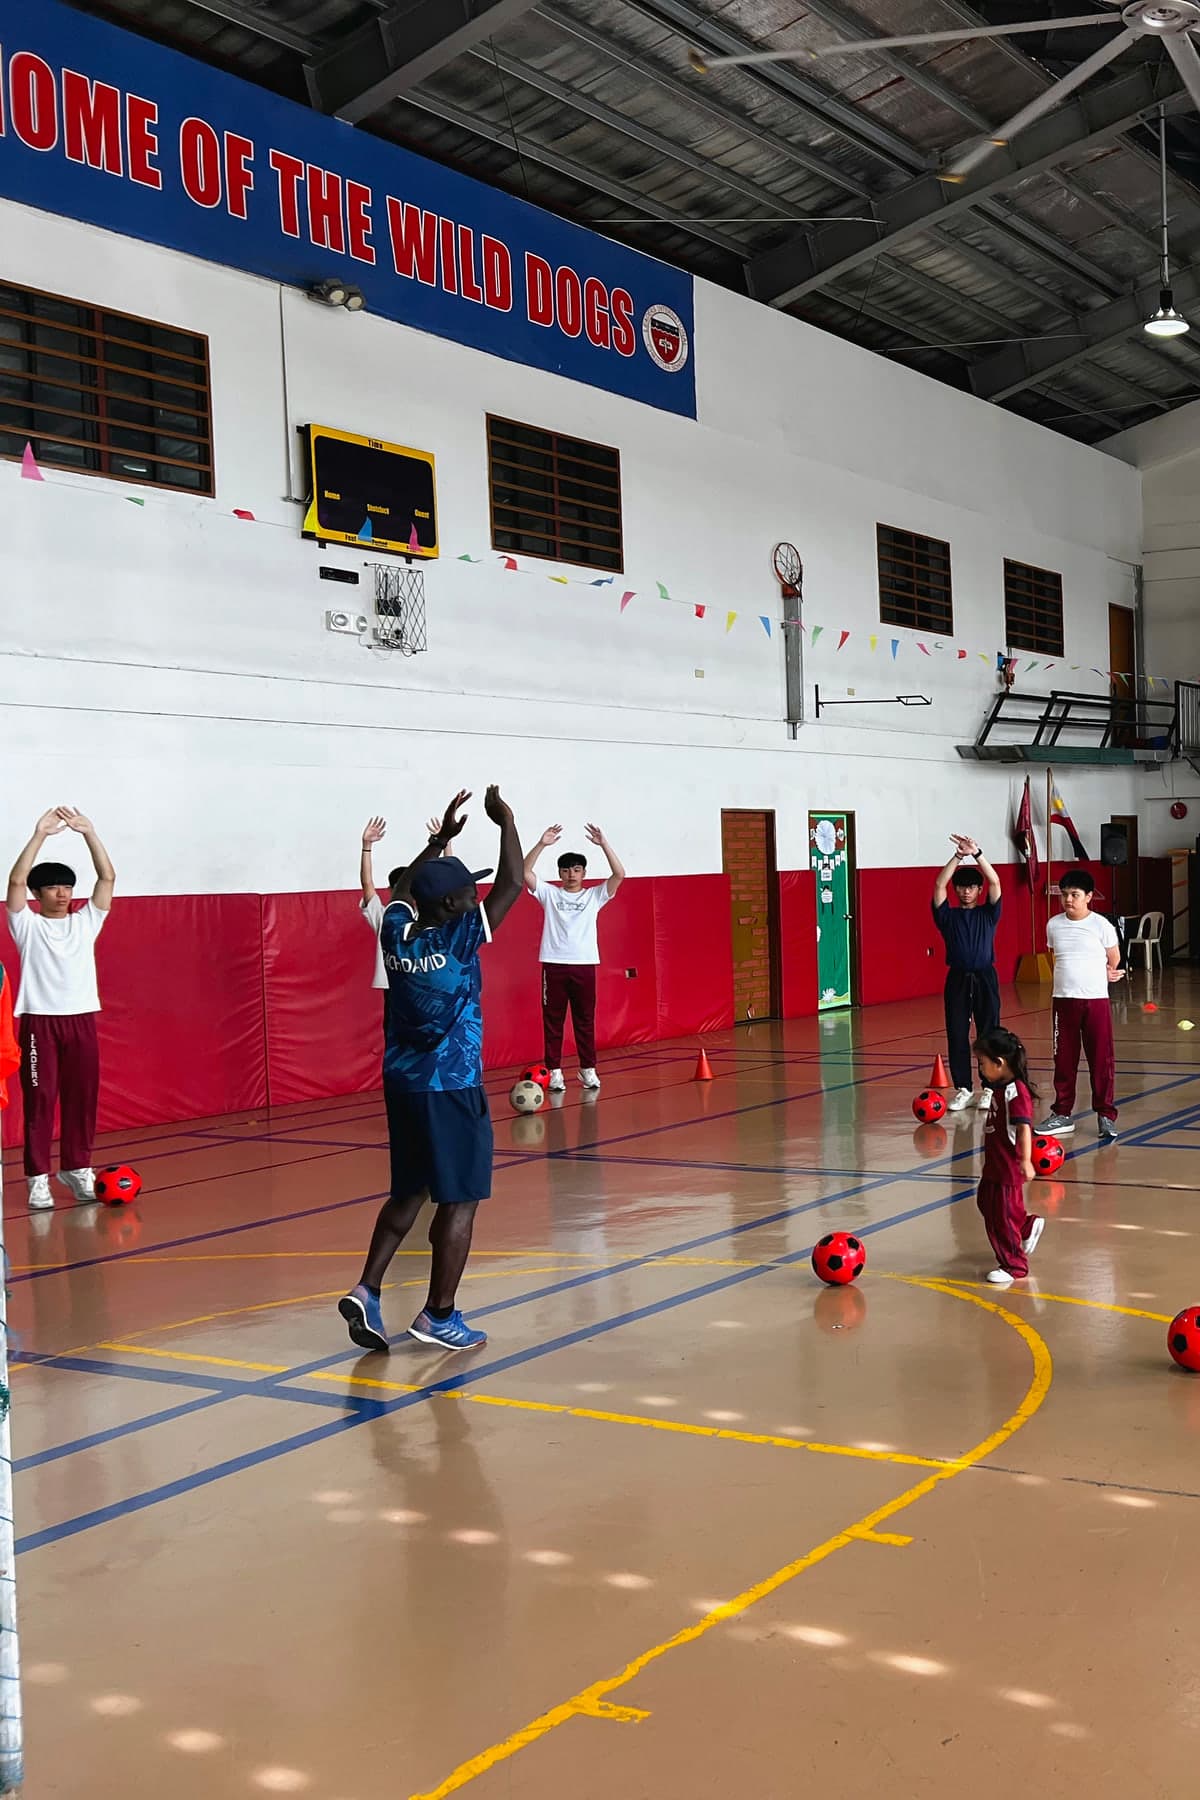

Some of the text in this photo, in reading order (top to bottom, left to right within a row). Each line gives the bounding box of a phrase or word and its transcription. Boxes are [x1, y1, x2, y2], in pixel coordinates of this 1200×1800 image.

[0, 43, 162, 190] OME
[179, 117, 254, 220] OF
[268, 148, 376, 266] THE
[386, 195, 513, 312] WILD
[525, 251, 636, 357] DOGS
